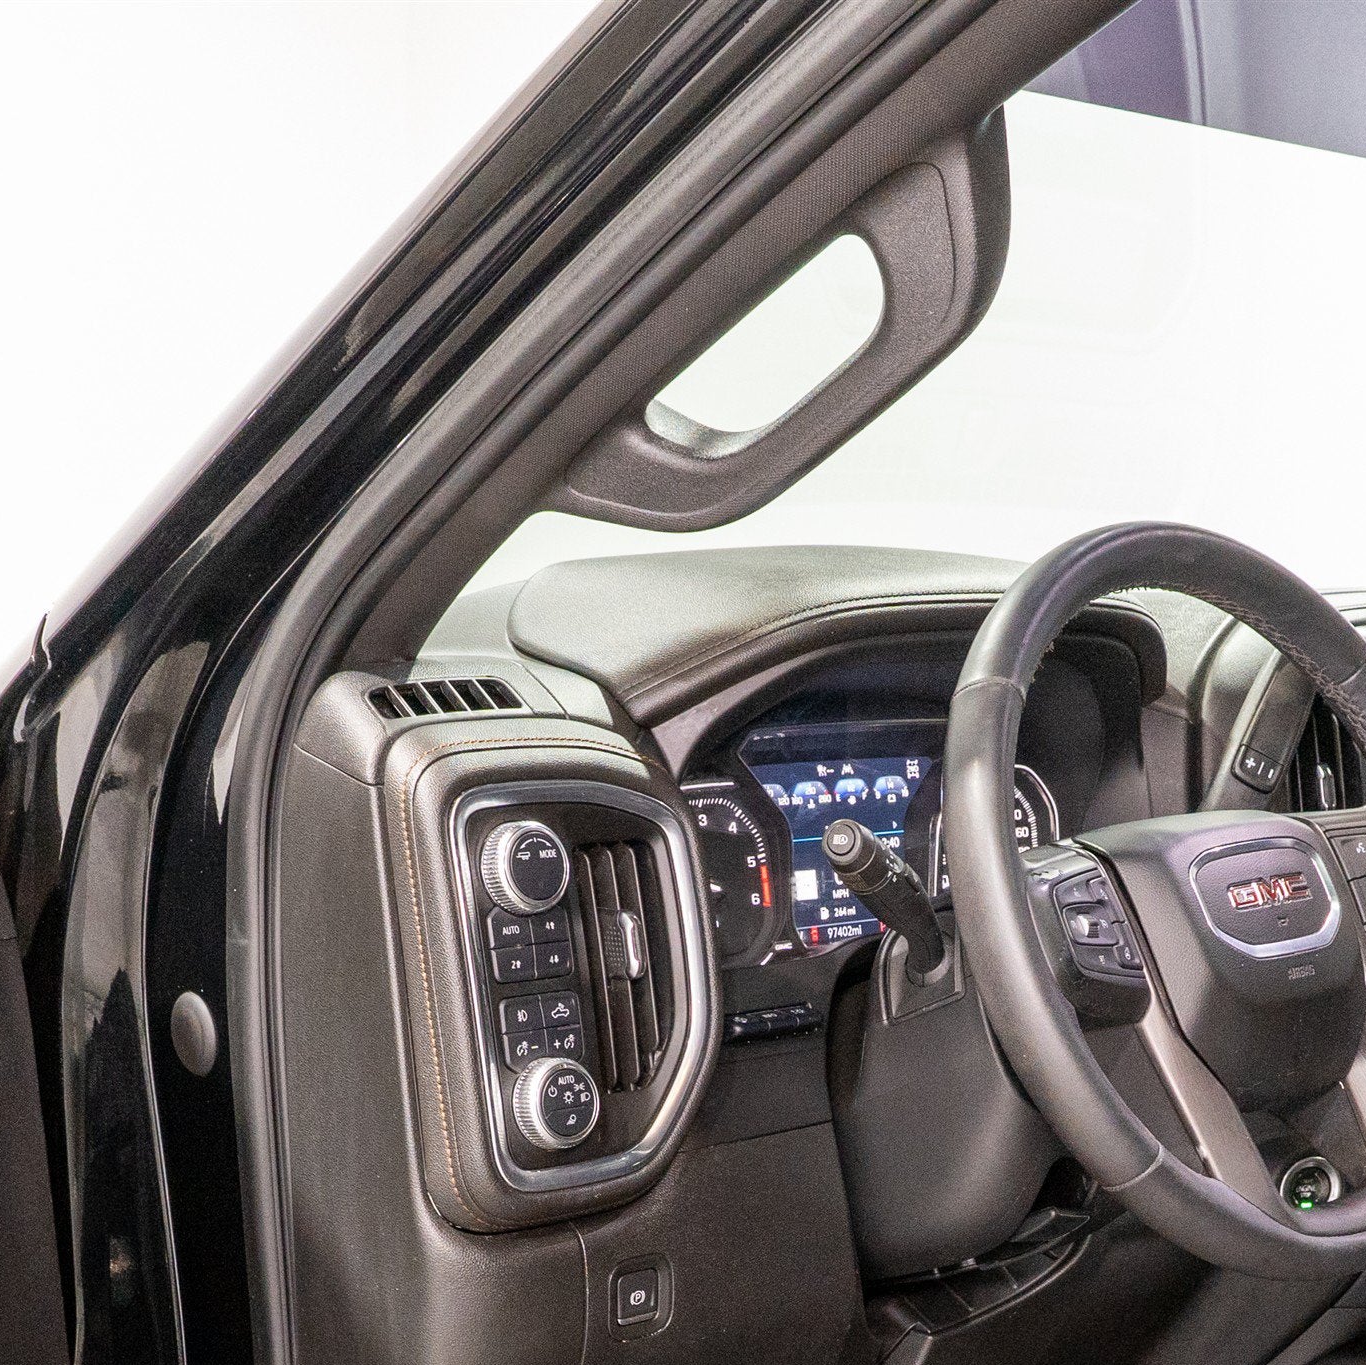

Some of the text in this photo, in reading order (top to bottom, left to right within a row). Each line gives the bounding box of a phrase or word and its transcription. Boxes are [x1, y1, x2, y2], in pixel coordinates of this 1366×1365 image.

[698, 814, 708, 826] 3
[728, 821, 737, 834] 4
[1015, 826, 1029, 838] 60
[539, 849, 557, 859] MODE
[747, 856, 756, 868] 5
[832, 889, 849, 899] MPH
[1227, 871, 1313, 911] GMC
[751, 893, 761, 905] 6
[502, 925, 520, 936] AUTO
[558, 1075, 575, 1085] AUTO
